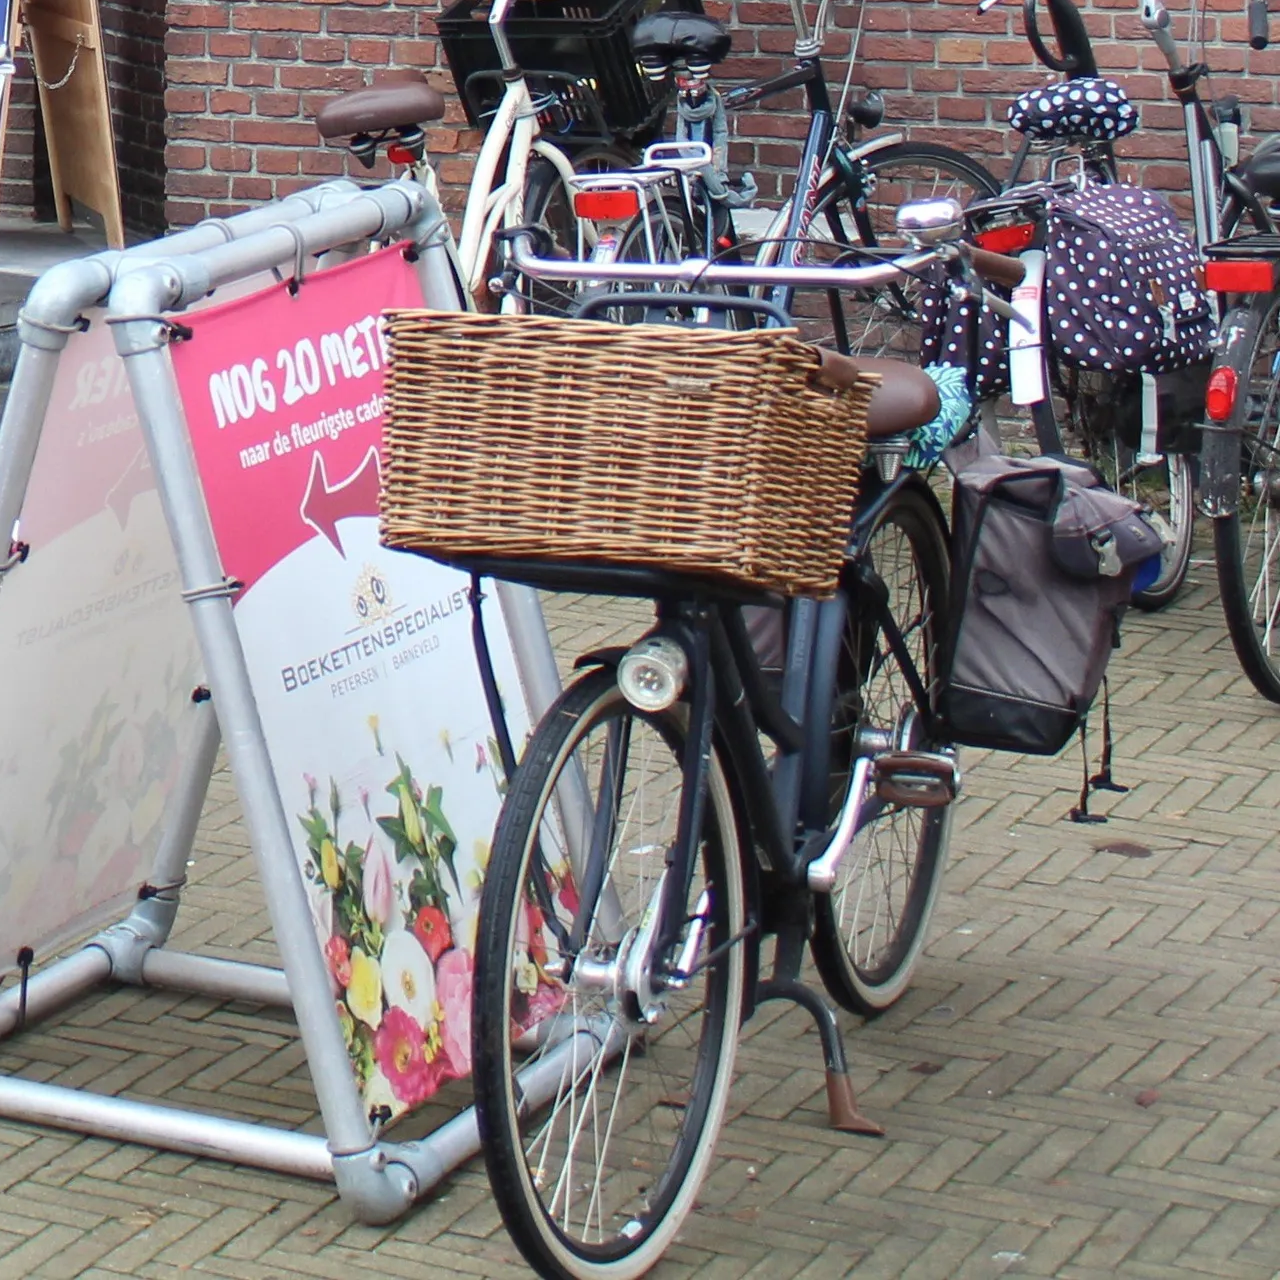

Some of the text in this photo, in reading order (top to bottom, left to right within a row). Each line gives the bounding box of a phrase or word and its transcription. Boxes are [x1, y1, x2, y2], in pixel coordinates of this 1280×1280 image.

[209, 358, 276, 429] NOG
[276, 338, 321, 405] 20
[240, 441, 271, 469] naar
[273, 431, 291, 456] de
[291, 408, 355, 449] fleurigste
[331, 635, 440, 698] PETERSEN BARNEVELD
